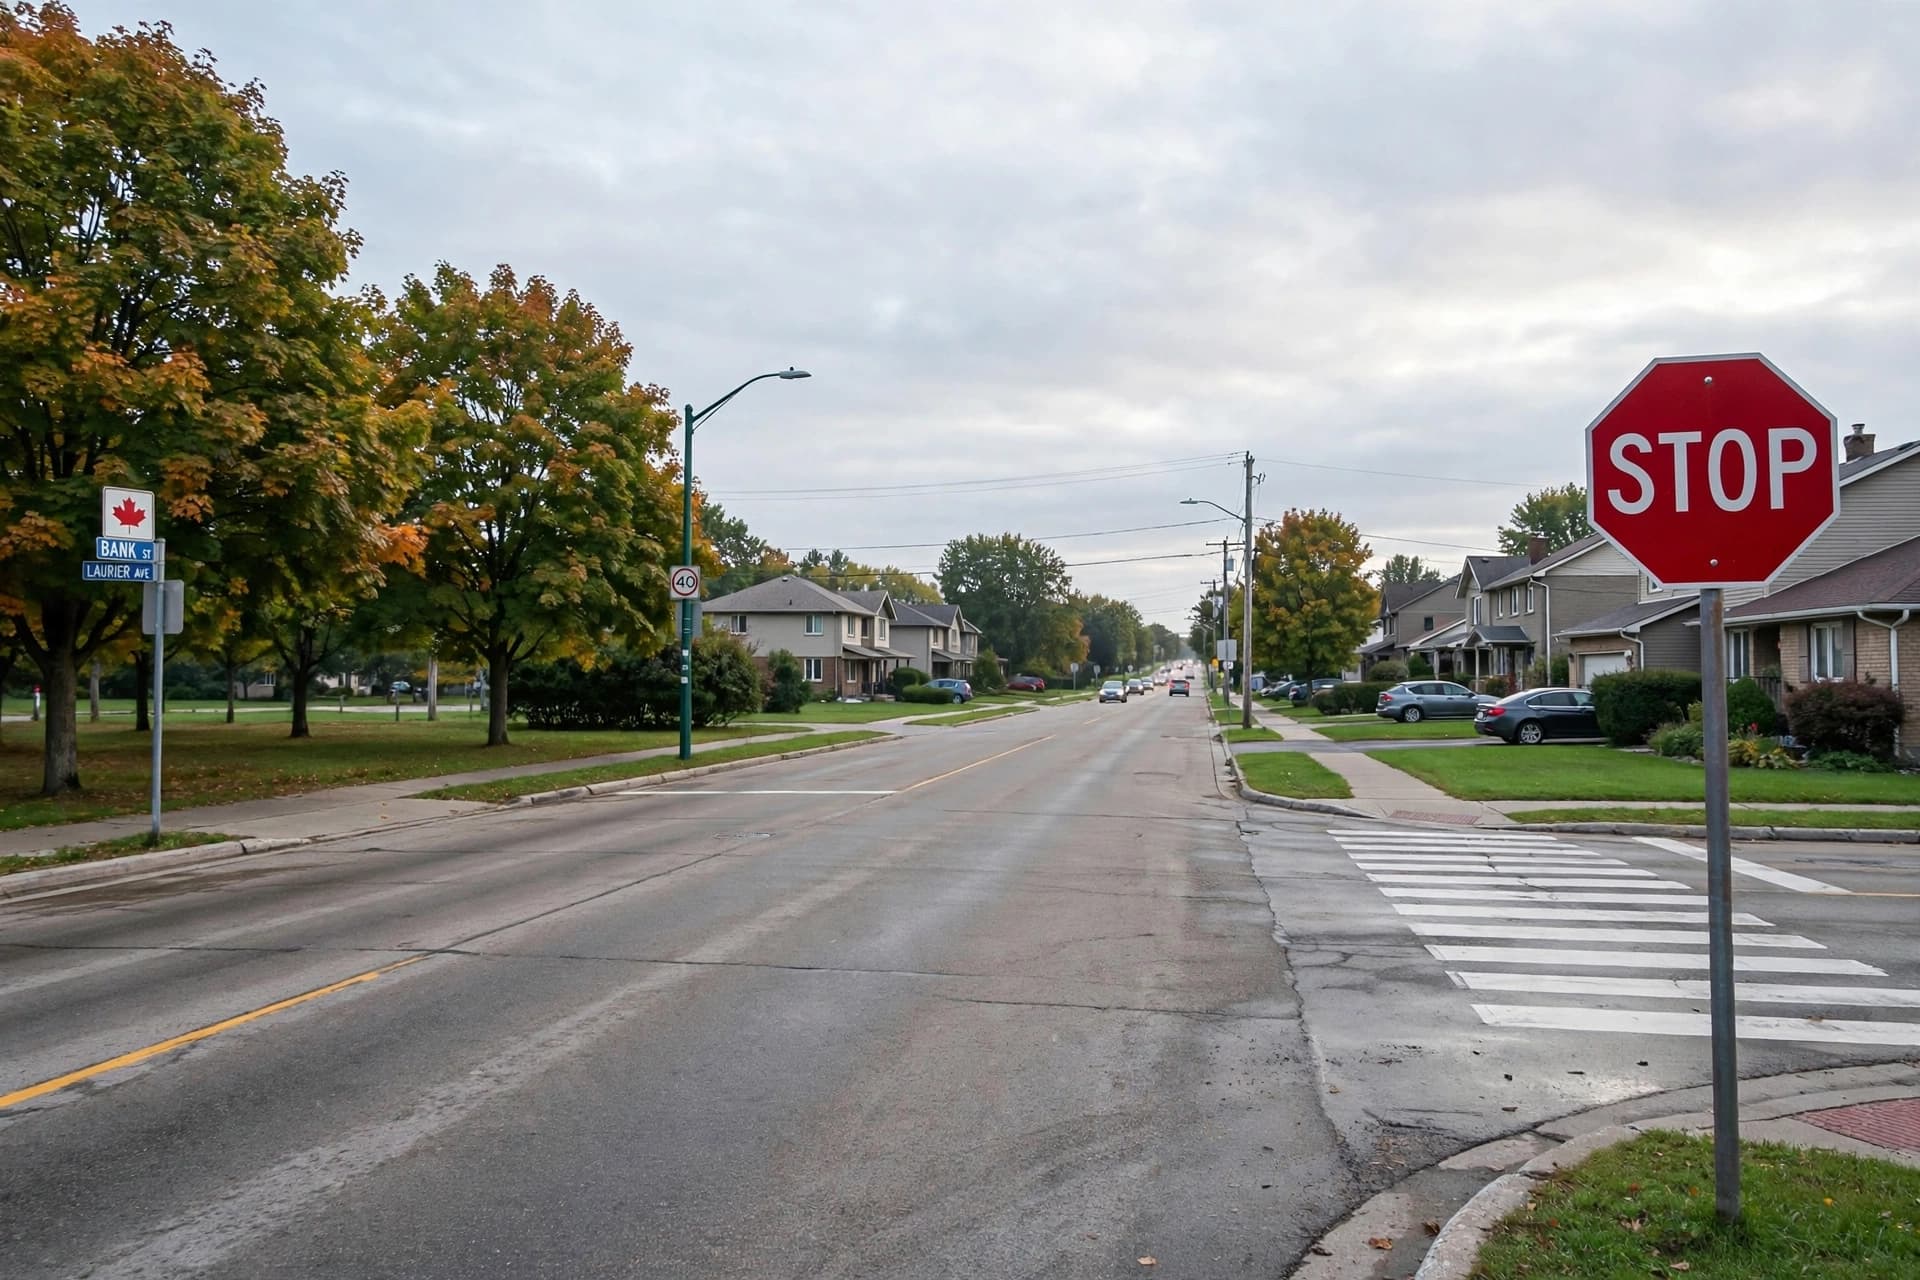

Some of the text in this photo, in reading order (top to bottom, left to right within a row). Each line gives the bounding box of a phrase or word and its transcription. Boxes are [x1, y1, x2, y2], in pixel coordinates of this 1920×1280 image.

[1607, 427, 1817, 515] STOP
[101, 540, 152, 559] BANK ST
[86, 564, 150, 579] LAURIER AVE
[676, 576, 695, 588] 40
